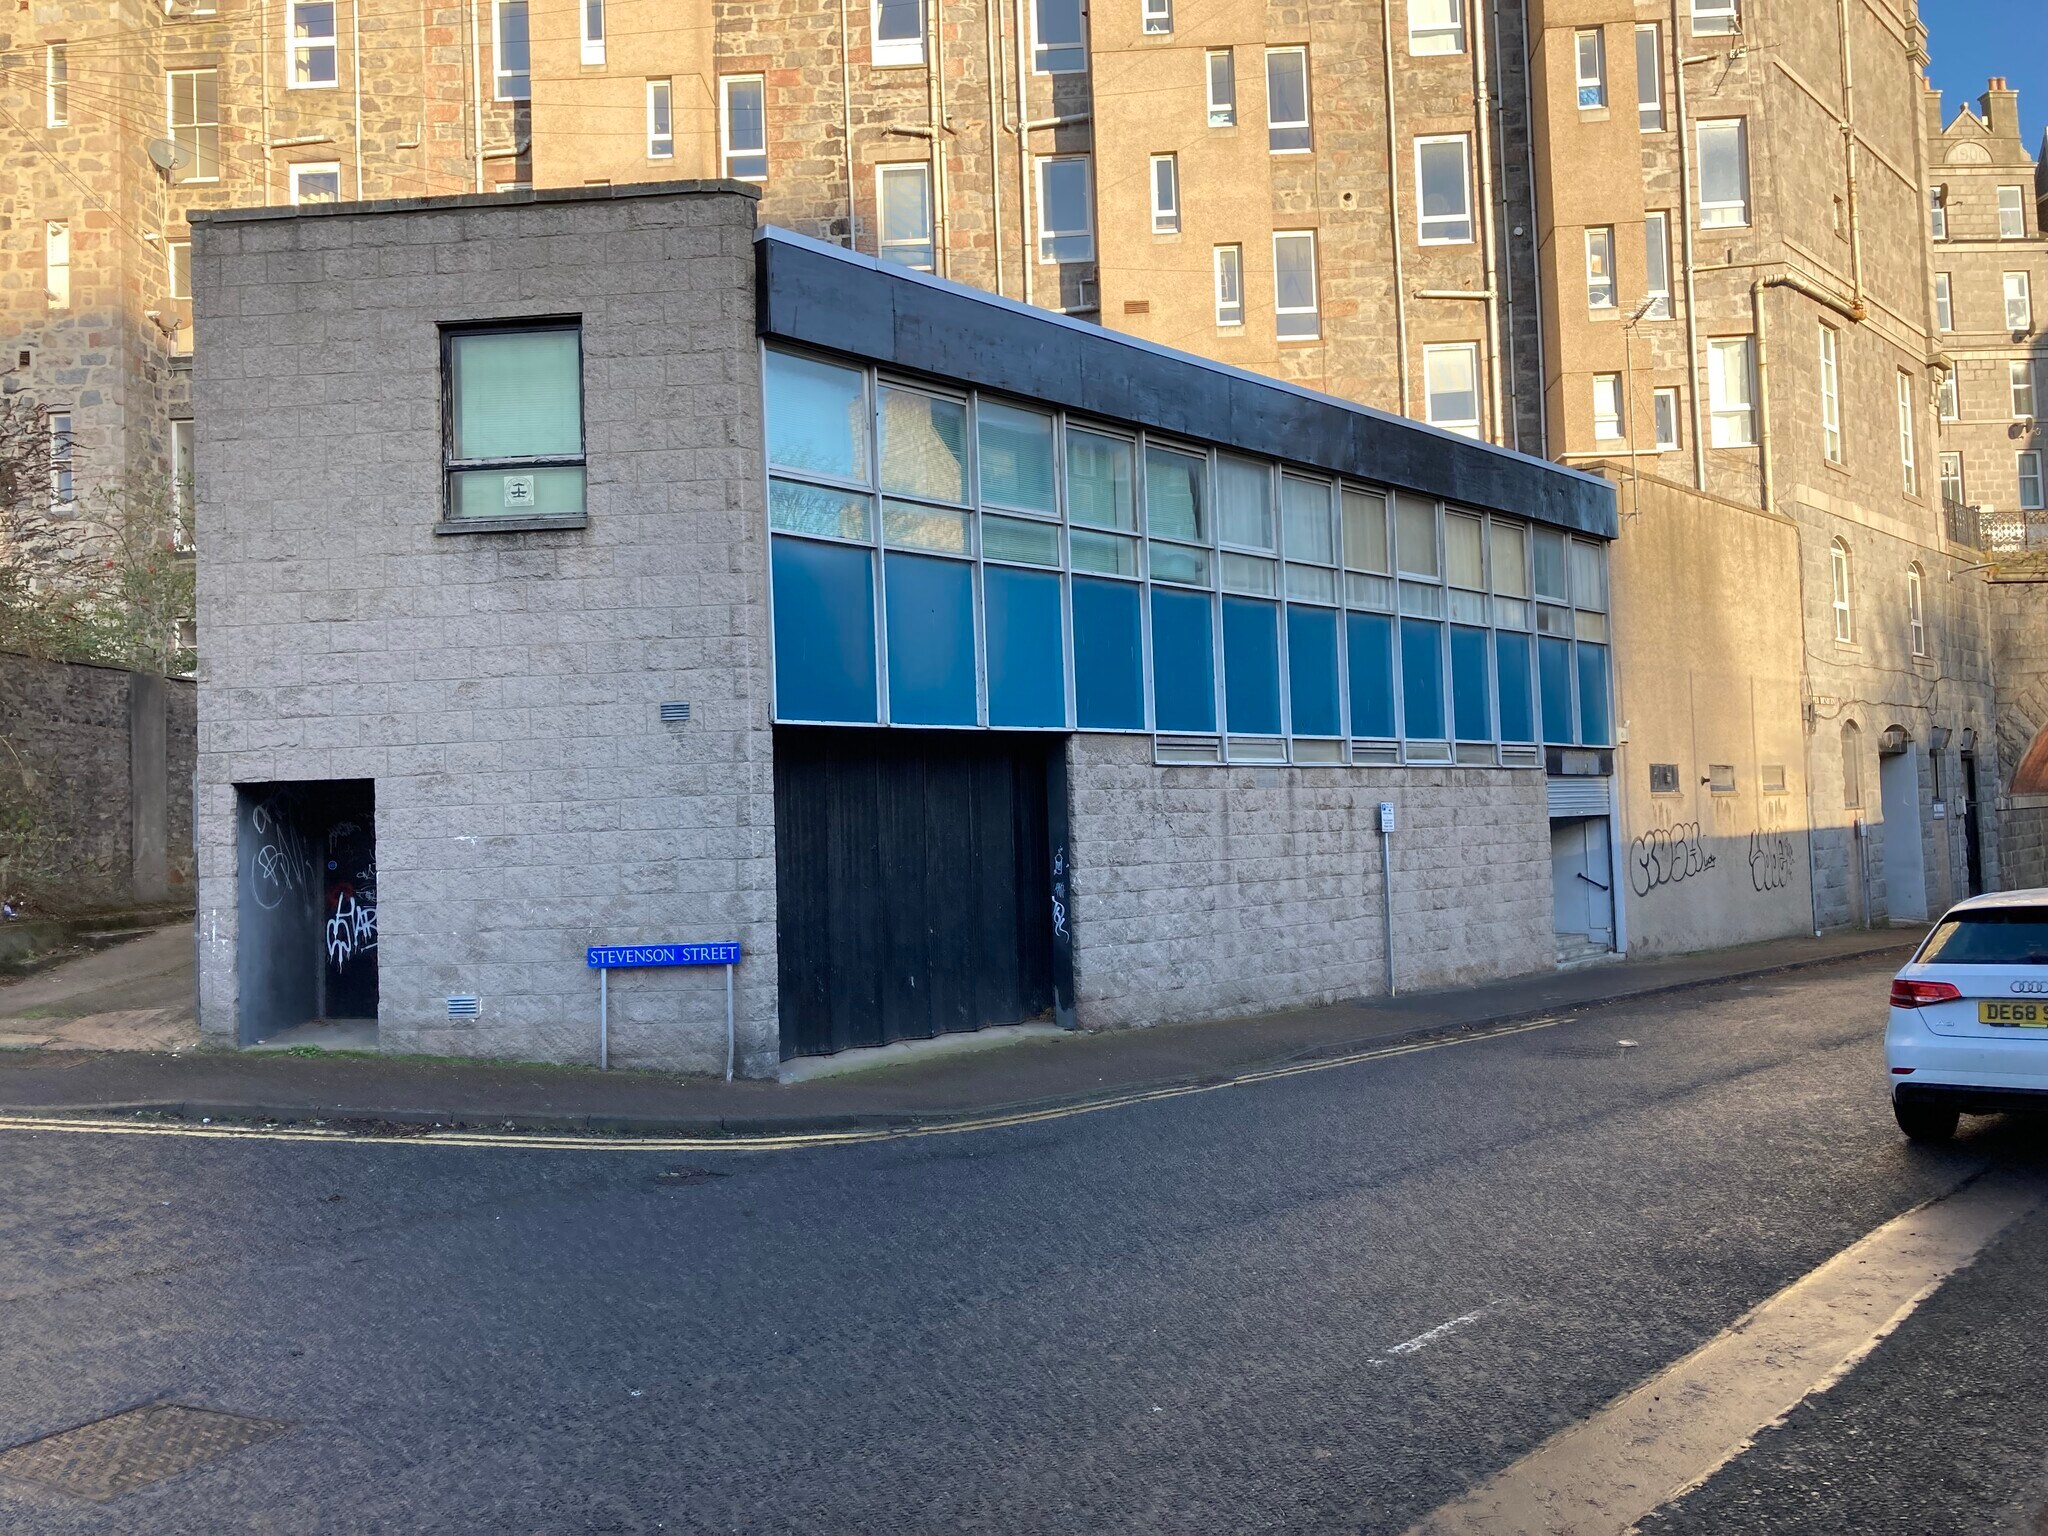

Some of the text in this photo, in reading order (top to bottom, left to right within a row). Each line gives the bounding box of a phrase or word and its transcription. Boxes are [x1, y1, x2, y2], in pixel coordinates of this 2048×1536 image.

[1955, 148, 1987, 161] 1900
[590, 946, 737, 964] STEVENSON STREET
[1987, 1004, 2037, 1020] DE68
